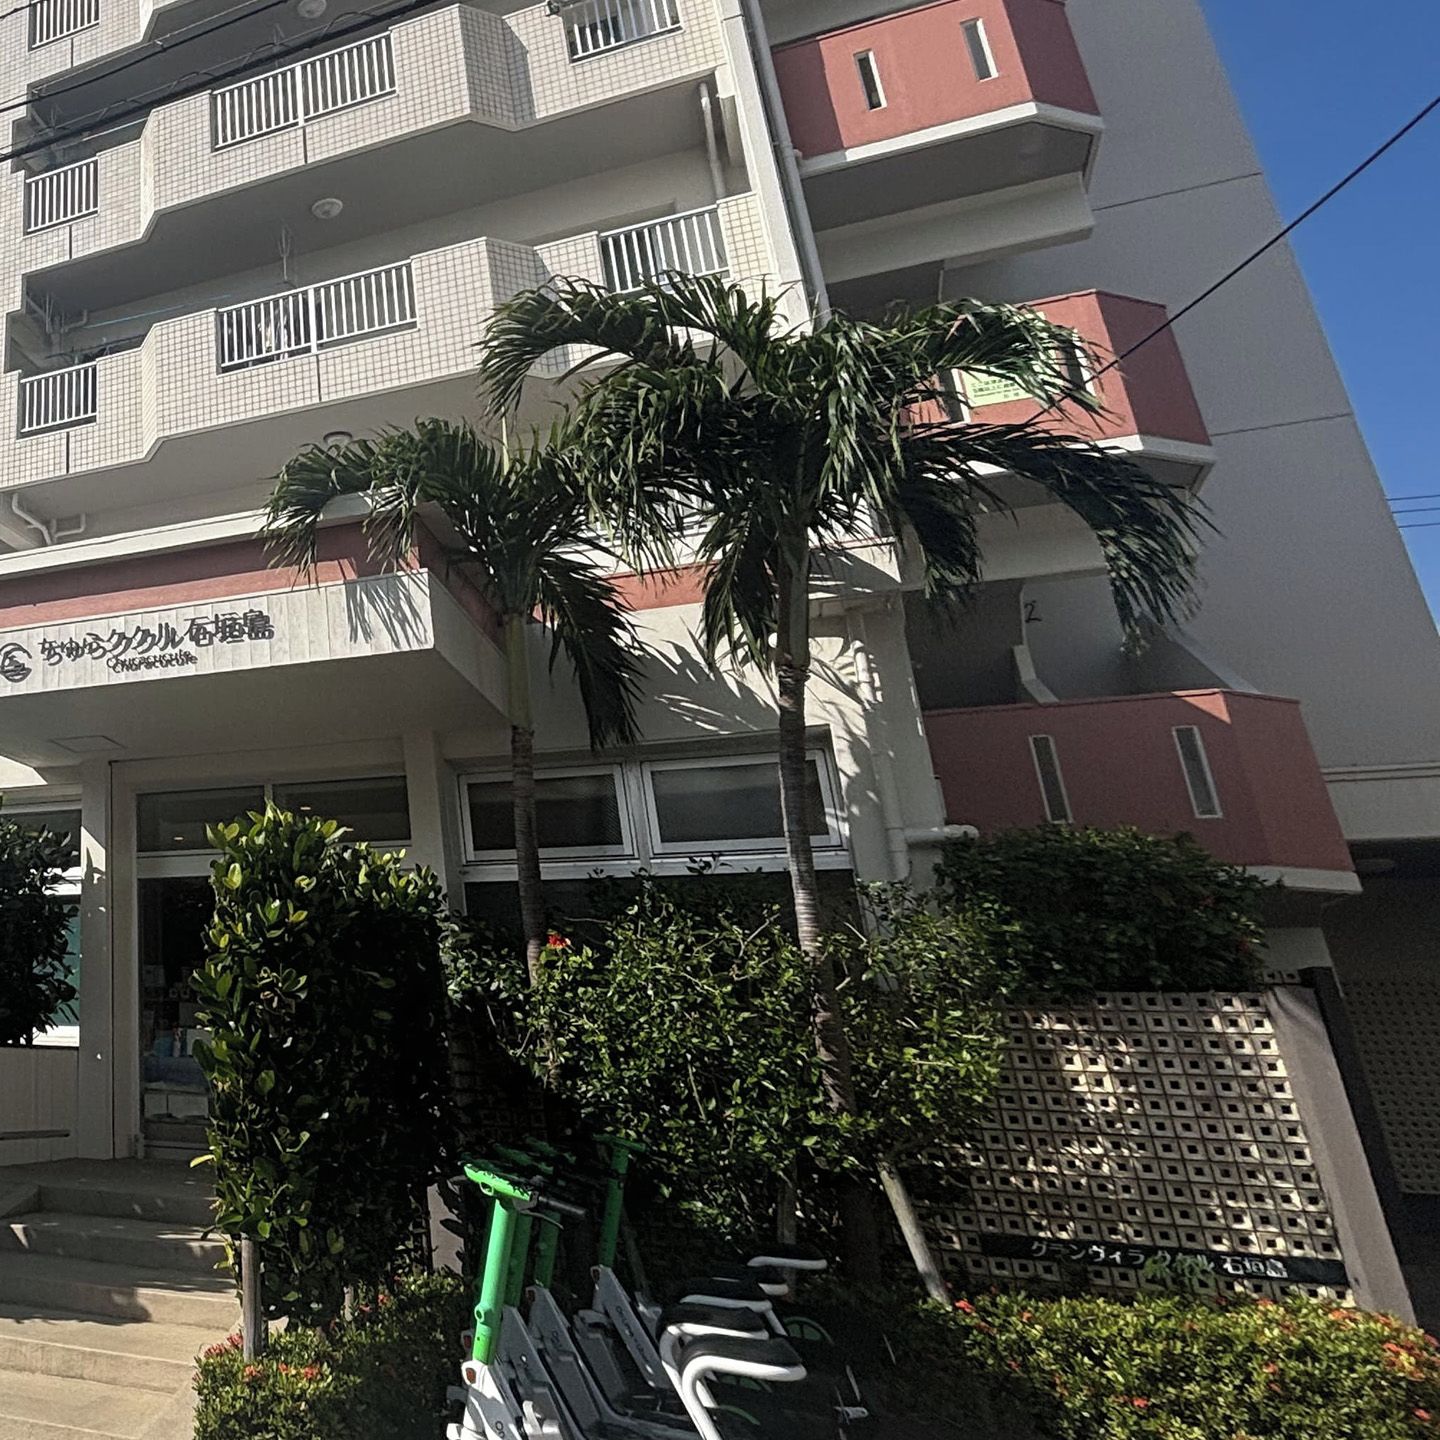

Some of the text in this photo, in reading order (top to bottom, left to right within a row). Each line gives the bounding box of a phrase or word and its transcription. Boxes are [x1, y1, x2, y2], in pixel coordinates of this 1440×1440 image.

[37, 608, 275, 666] ちゅらククル 石垣島
